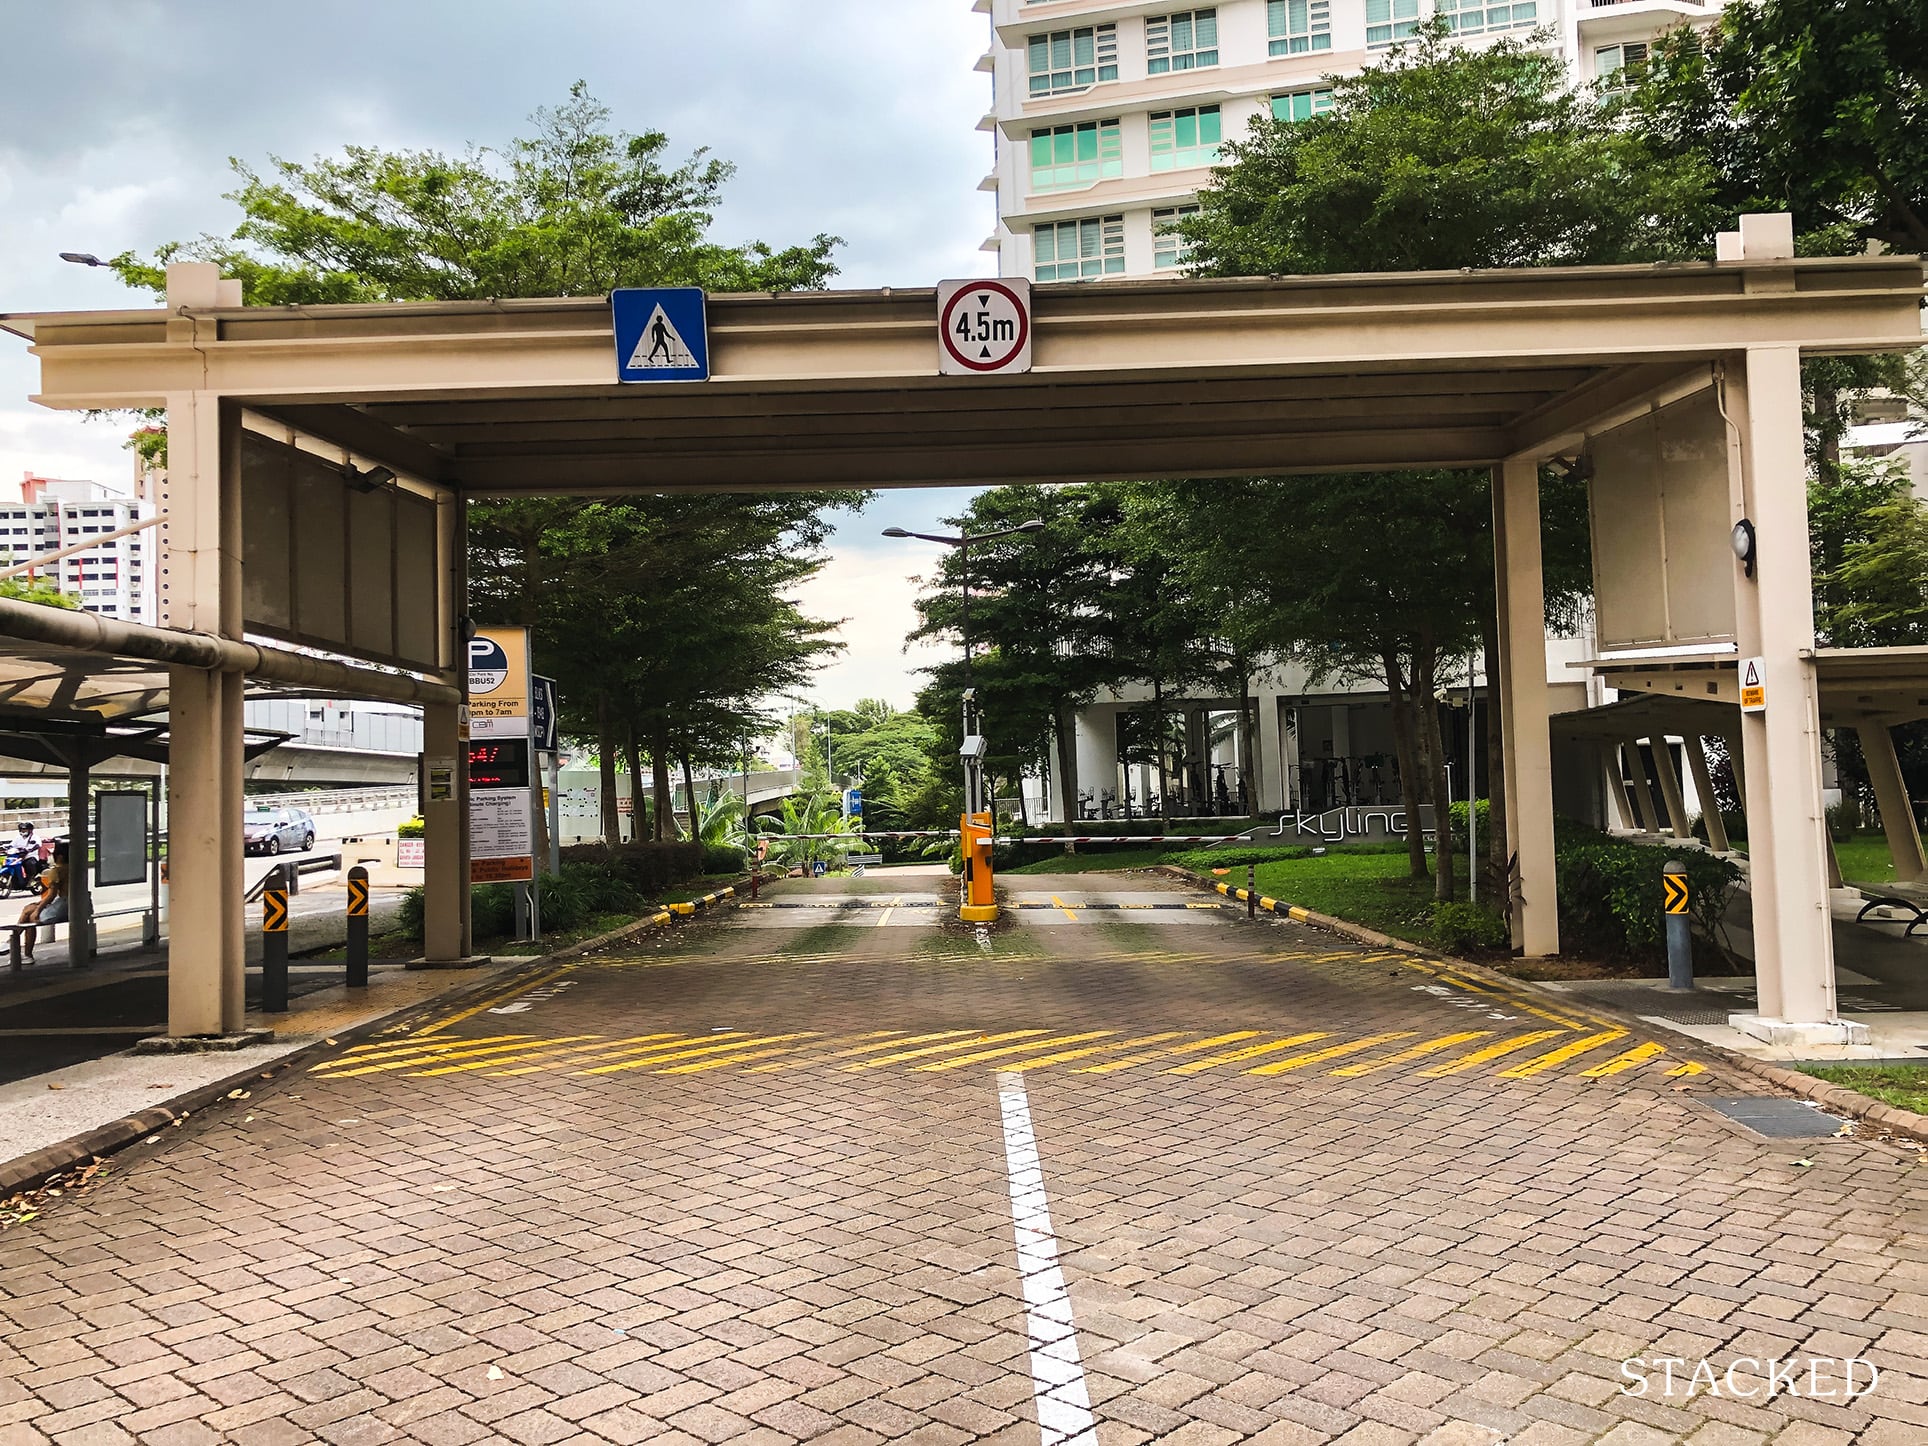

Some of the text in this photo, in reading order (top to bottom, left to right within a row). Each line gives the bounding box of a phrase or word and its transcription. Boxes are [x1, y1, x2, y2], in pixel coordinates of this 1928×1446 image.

[956, 311, 1014, 342] 4.5m
[468, 641, 495, 668] P
[496, 708, 513, 716] 7am
